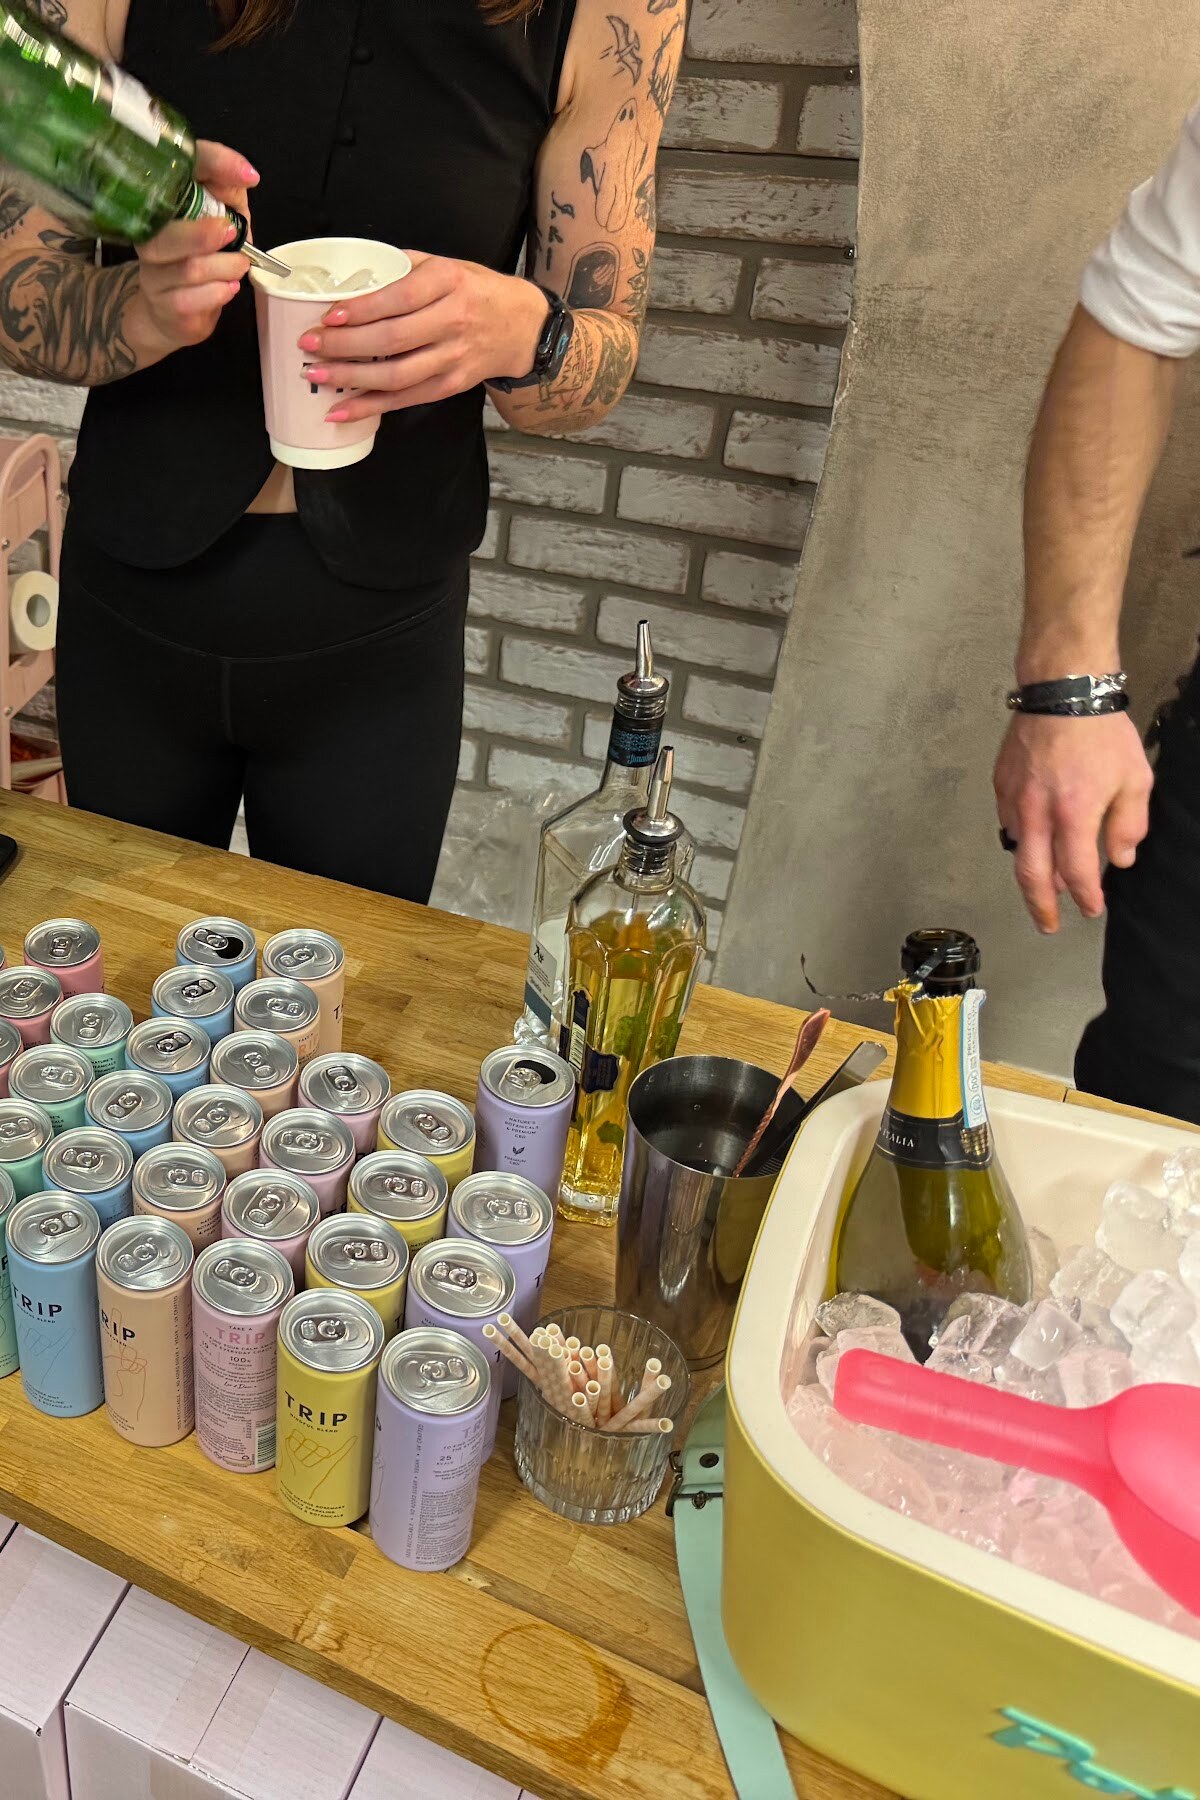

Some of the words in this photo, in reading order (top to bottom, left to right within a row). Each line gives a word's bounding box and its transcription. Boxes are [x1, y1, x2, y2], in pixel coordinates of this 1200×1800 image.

[504, 1121, 539, 1130] BOTANICALS
[508, 1117, 537, 1125] NATURE'S
[11, 1281, 63, 1317] TRIP
[101, 1309, 136, 1341] RIP
[216, 1327, 266, 1345] TRIP
[285, 1390, 348, 1426] TRIP
